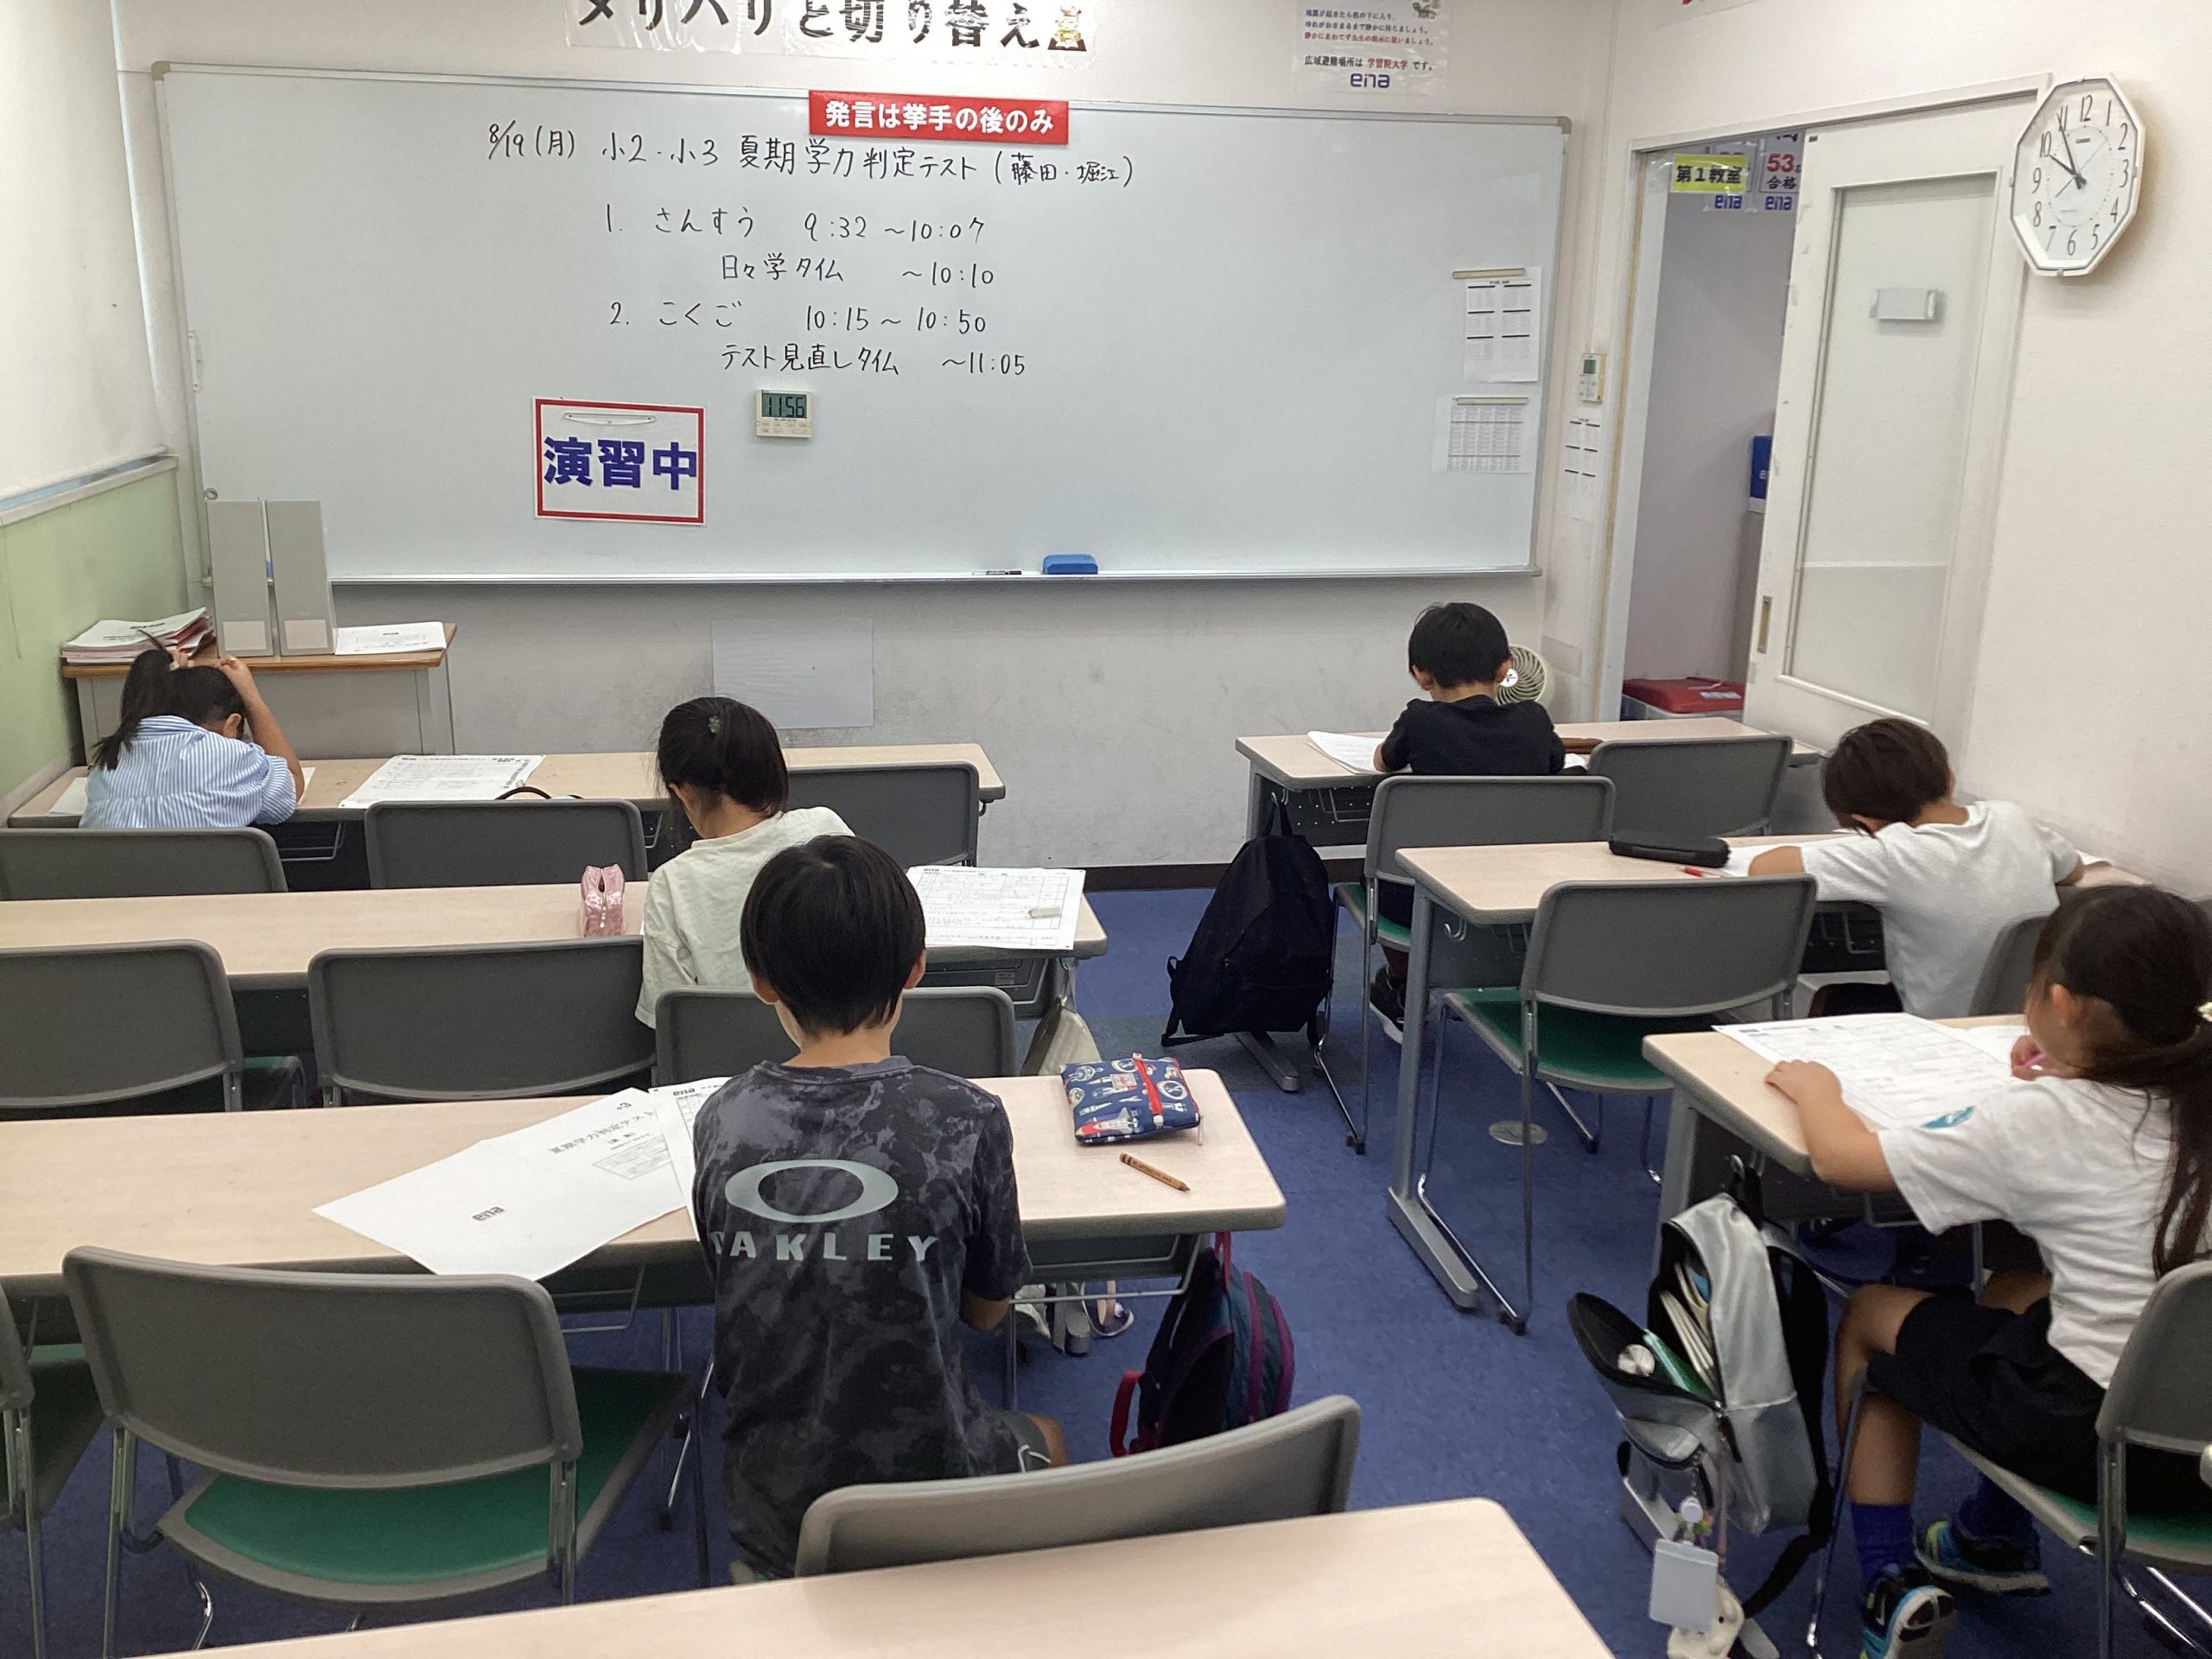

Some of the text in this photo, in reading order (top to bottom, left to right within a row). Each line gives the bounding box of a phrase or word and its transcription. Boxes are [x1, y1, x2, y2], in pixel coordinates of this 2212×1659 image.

[1368, 58, 1408, 70] 学習院大学
[1350, 73, 1390, 88] ena
[825, 100, 1054, 134] 発言は挙手の後のみ
[2081, 94, 2093, 123] 12
[2107, 99, 2113, 127] 1
[2039, 130, 2052, 158] 10
[2117, 122, 2128, 151] 2
[1676, 165, 1743, 184] 第1教室
[1767, 175, 1797, 189] 合格
[2031, 167, 2042, 194] 9
[2119, 158, 2130, 188] 3
[1715, 195, 1742, 209] ena
[1765, 196, 1793, 210] ena
[2032, 200, 2043, 227] 8
[2109, 196, 2120, 223] 4
[656, 207, 753, 238] さんすう
[2045, 225, 2057, 252] 7
[2067, 229, 2078, 256] 6
[2090, 223, 2101, 251] 5
[722, 252, 844, 282] 日々学タイム
[659, 300, 742, 327] こくご
[721, 343, 899, 376] テスト見直しタイム
[543, 436, 697, 490] 演習中
[472, 1206, 505, 1221] ena
